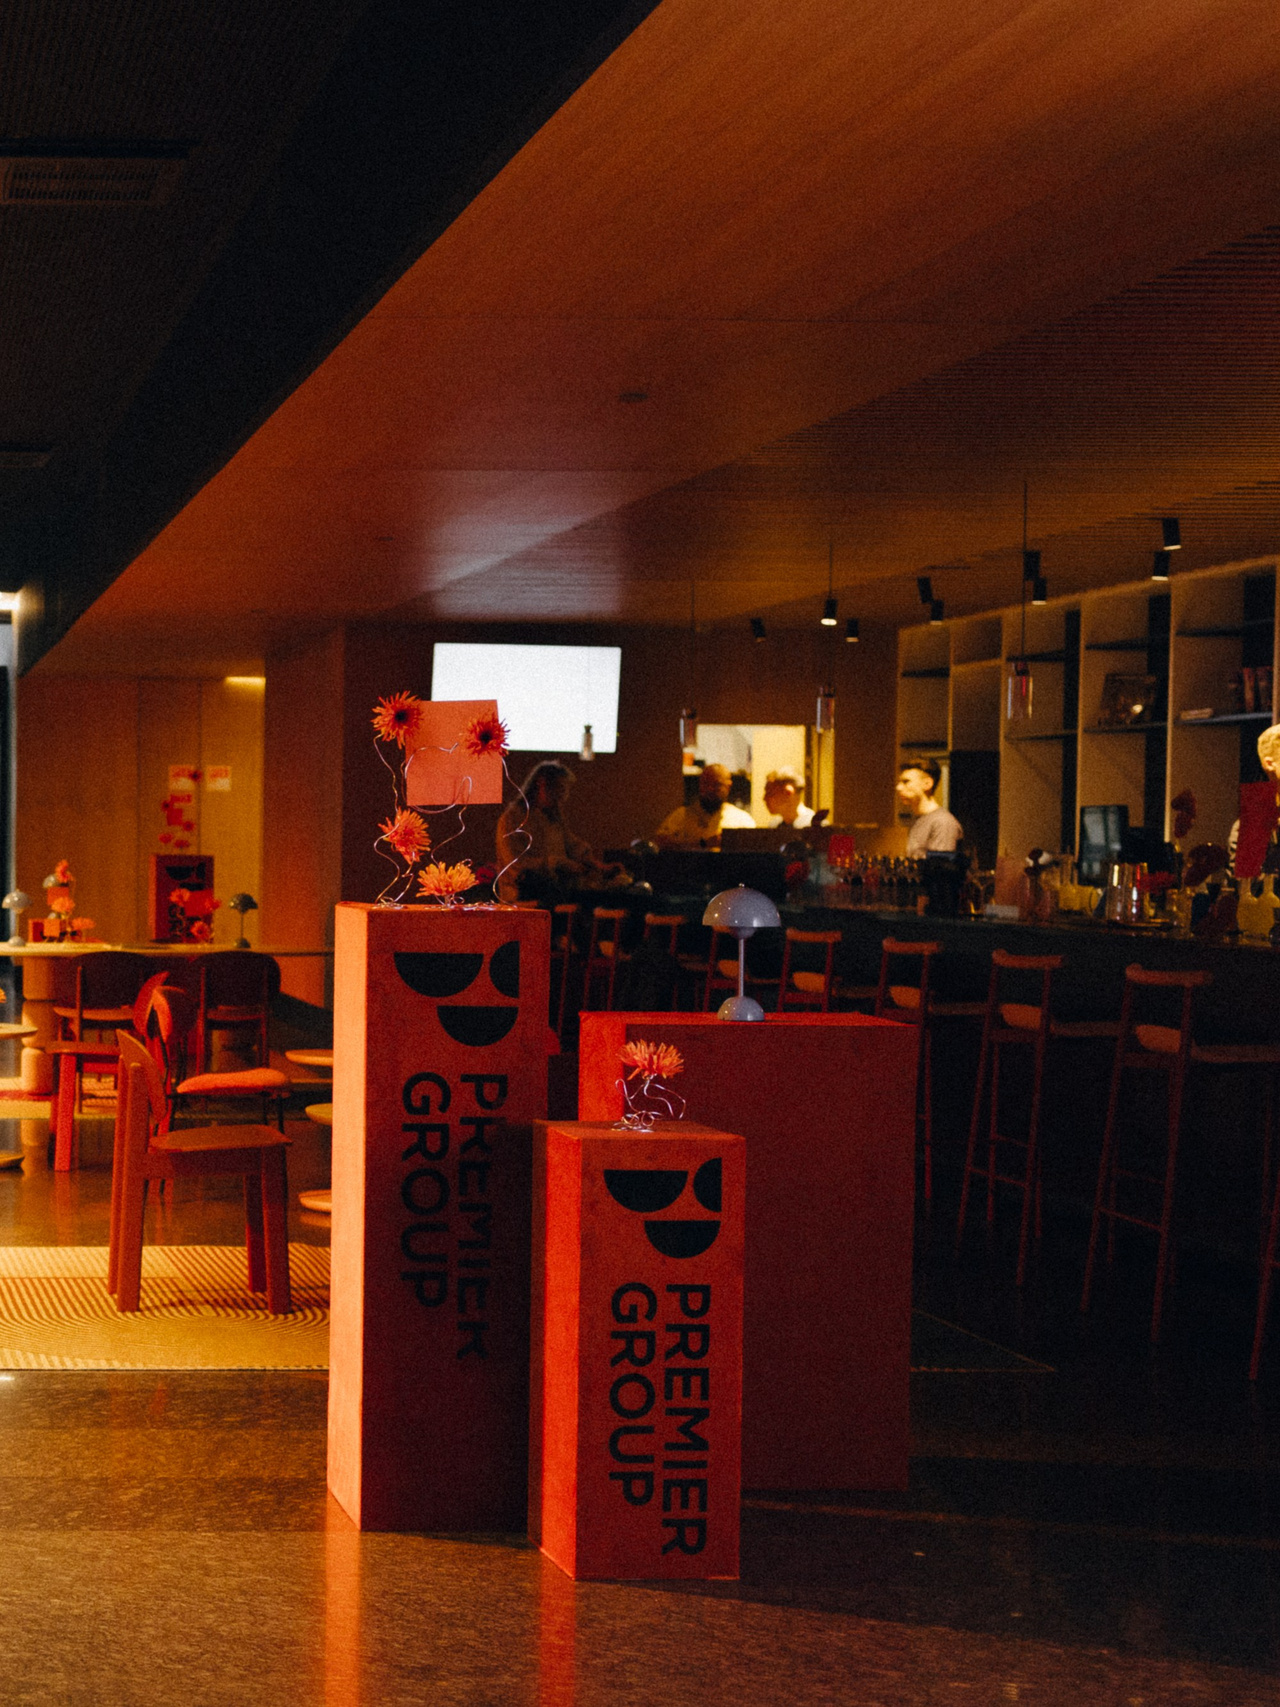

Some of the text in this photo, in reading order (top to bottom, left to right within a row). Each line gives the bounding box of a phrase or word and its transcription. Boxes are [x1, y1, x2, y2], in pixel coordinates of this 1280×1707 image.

[401, 1072, 452, 1308] GROUP
[458, 1074, 508, 1360] PREMIER
[609, 1281, 658, 1507] GROUP
[661, 1283, 711, 1556] PREMIER
